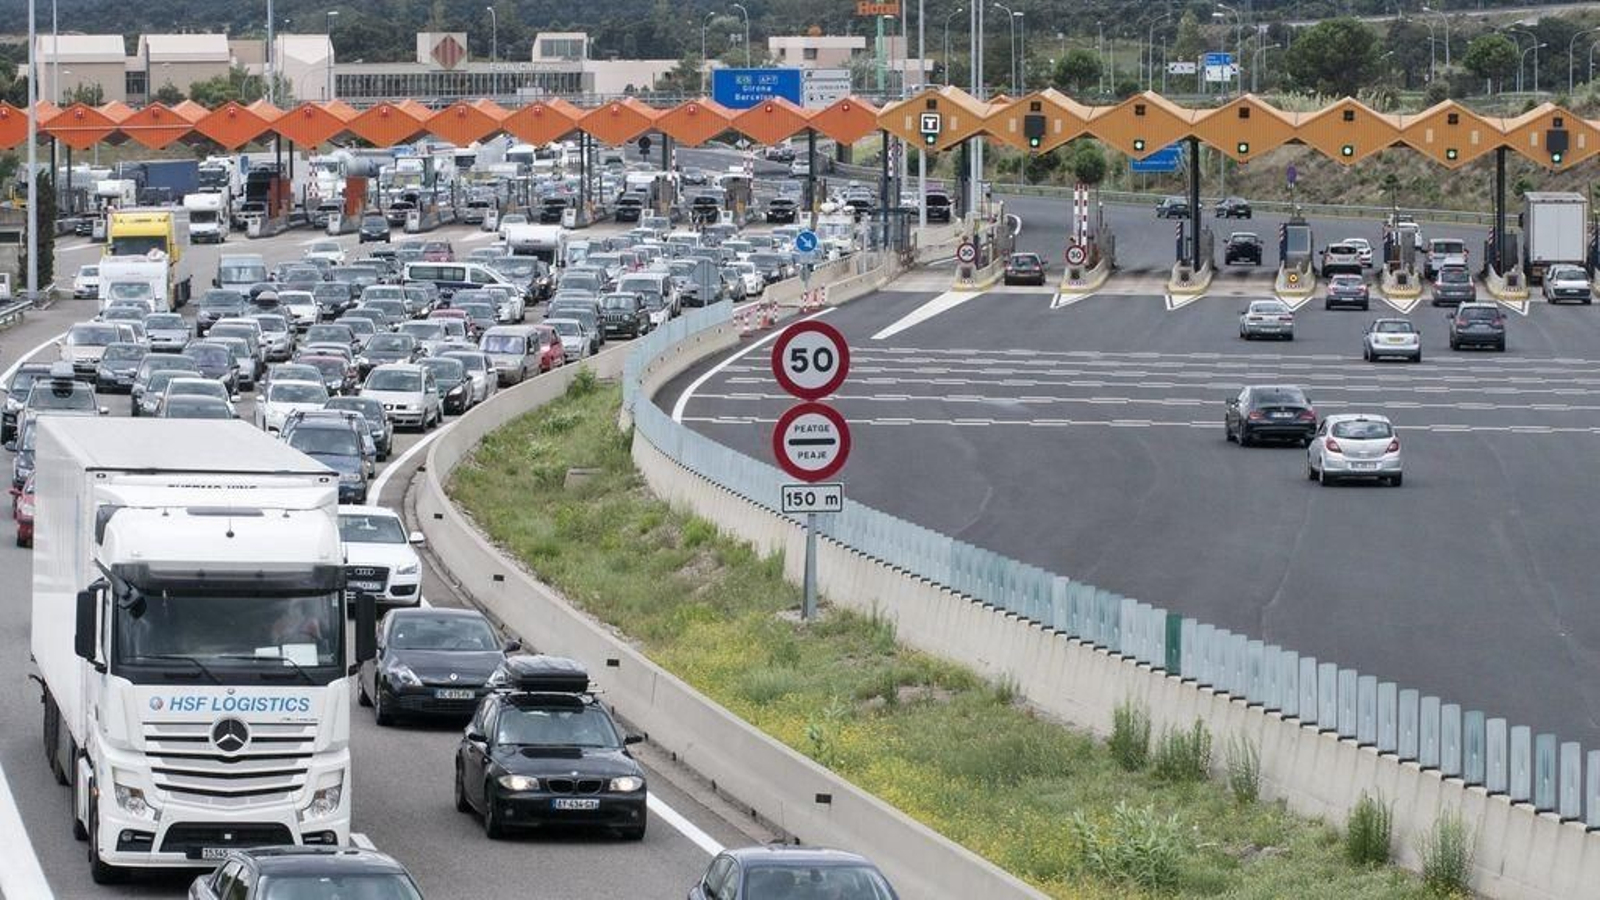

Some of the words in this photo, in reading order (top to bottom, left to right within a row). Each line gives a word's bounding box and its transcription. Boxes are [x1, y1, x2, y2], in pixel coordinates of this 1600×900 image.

[1070, 251, 1082, 259] 30
[790, 347, 833, 373] 50
[794, 424, 830, 433] PEATGE
[798, 452, 827, 460] PEAJE
[786, 491, 816, 506] 150
[825, 493, 838, 505] m
[170, 696, 206, 711] HSF
[212, 696, 310, 712] LOGISTICS
